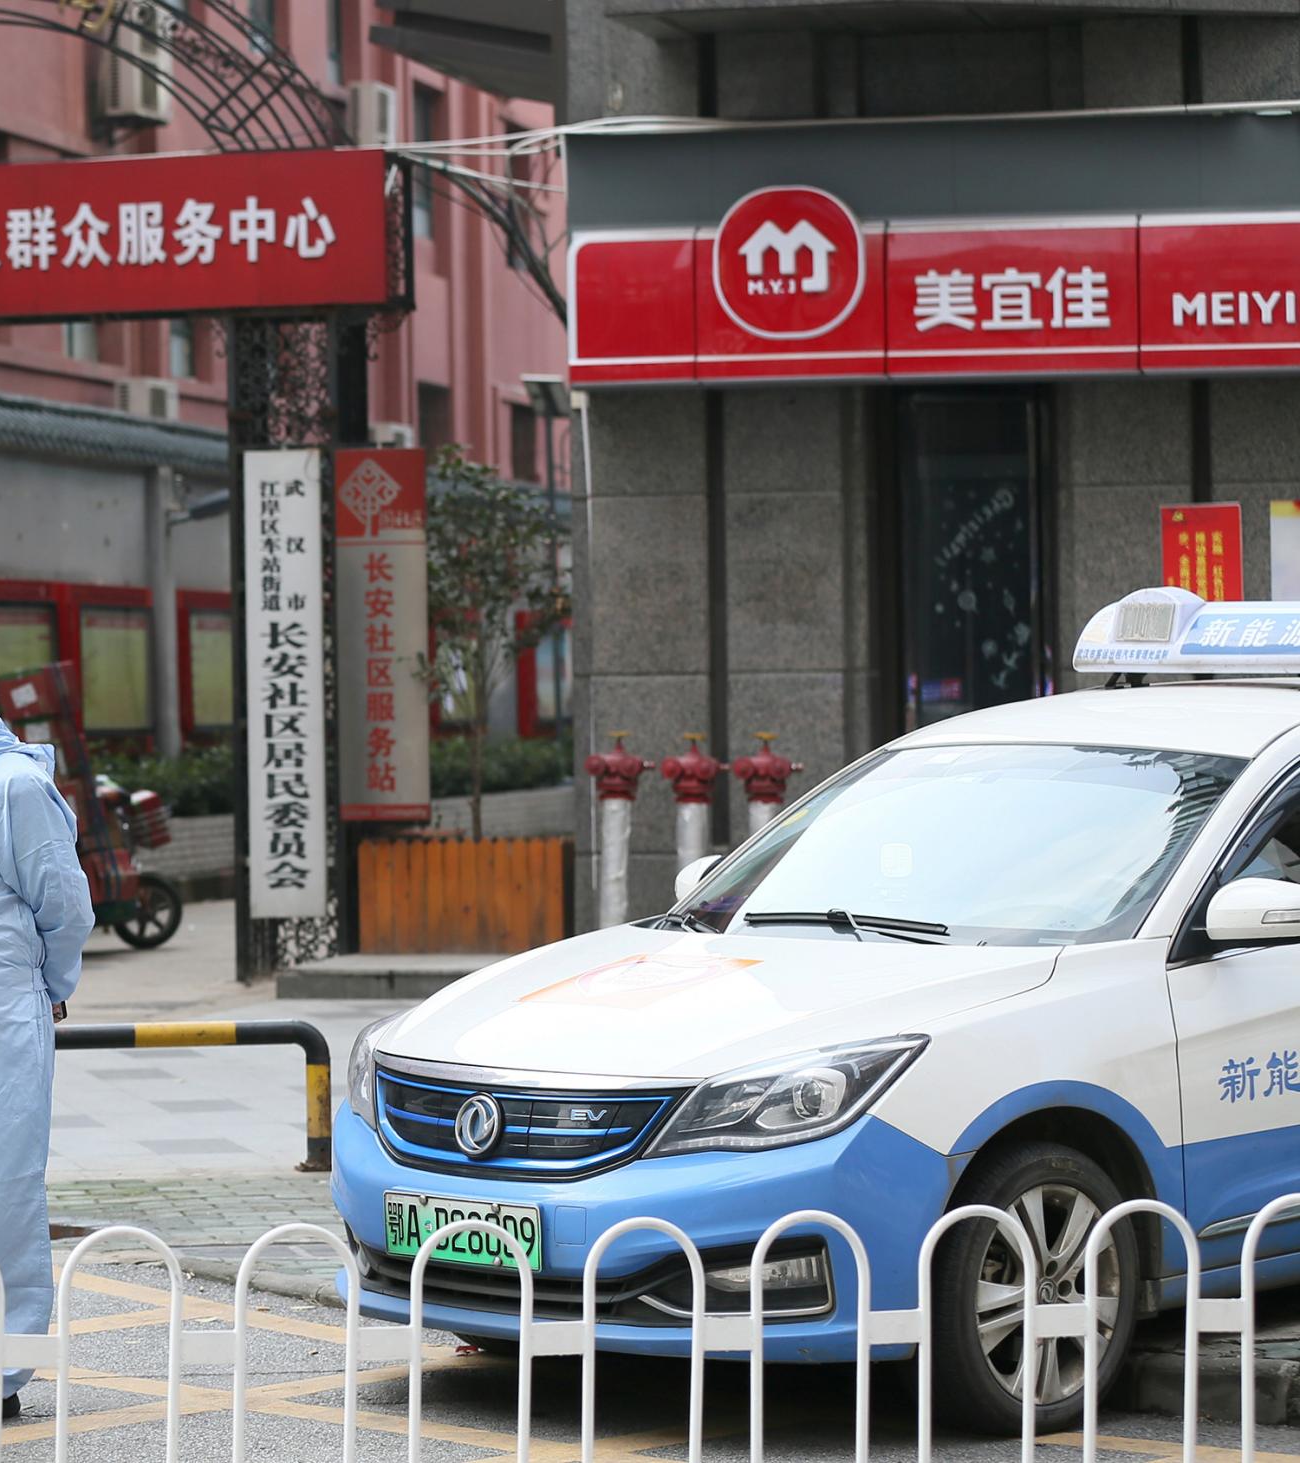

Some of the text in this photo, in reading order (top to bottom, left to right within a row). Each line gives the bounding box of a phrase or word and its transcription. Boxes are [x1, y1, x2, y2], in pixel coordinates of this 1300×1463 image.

[913, 266, 1111, 331] 美宜佳
[1172, 291, 1296, 326] MEIYI
[259, 480, 281, 611] 江岸区车站街道
[284, 479, 306, 611] 武汉市
[363, 553, 397, 793] 长安社区服务站
[261, 621, 310, 890] 长安社区居民委员会
[570, 1108, 608, 1121] EV
